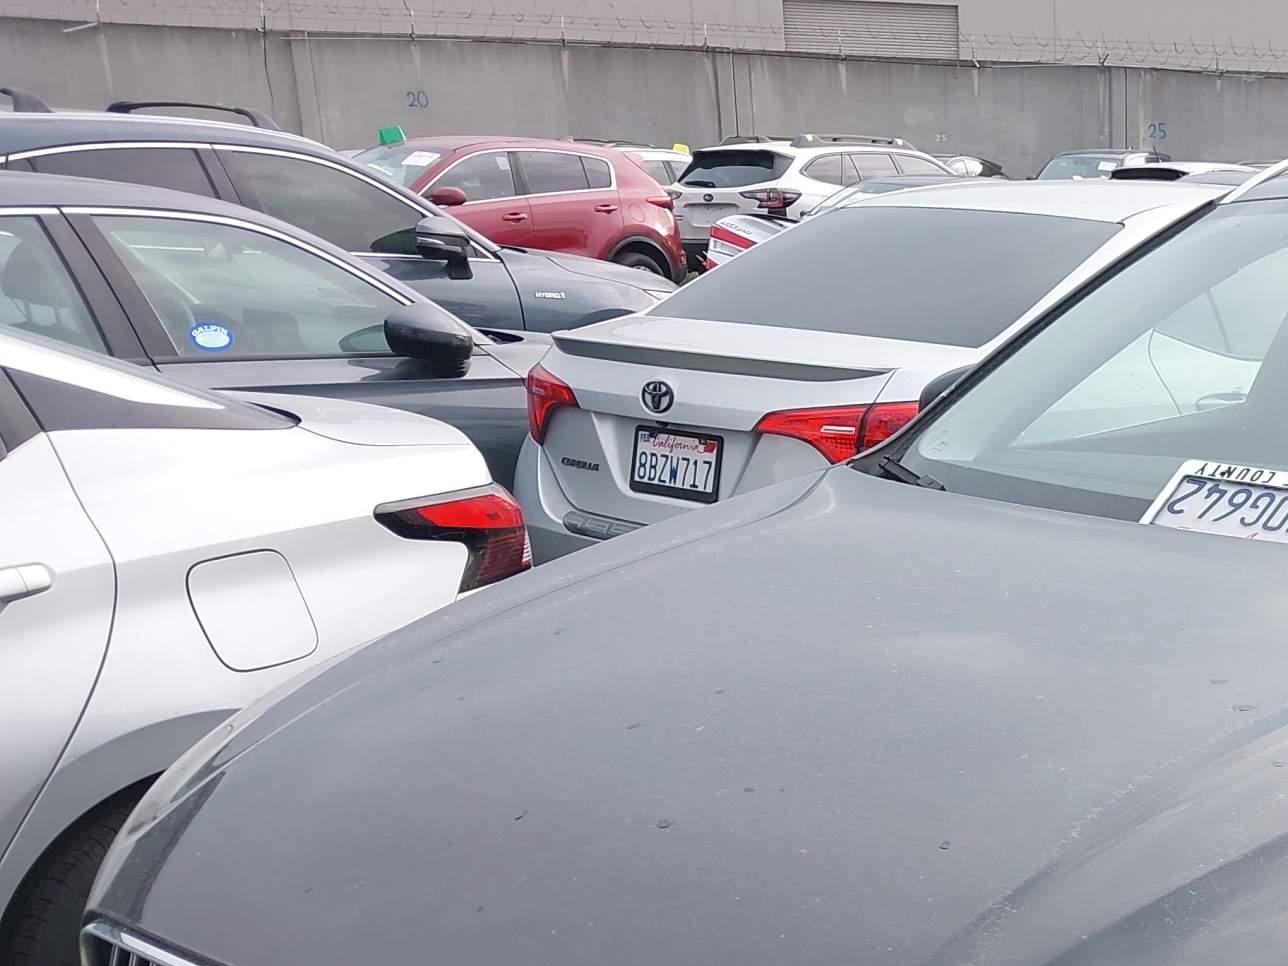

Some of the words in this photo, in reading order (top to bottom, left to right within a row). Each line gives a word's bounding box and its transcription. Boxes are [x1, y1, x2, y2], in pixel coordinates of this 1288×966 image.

[406, 90, 429, 109] 20
[1148, 122, 1167, 139] 25
[652, 433, 705, 454] California
[637, 450, 713, 491] 8BZW717
[1194, 462, 1276, 484] COUNTY
